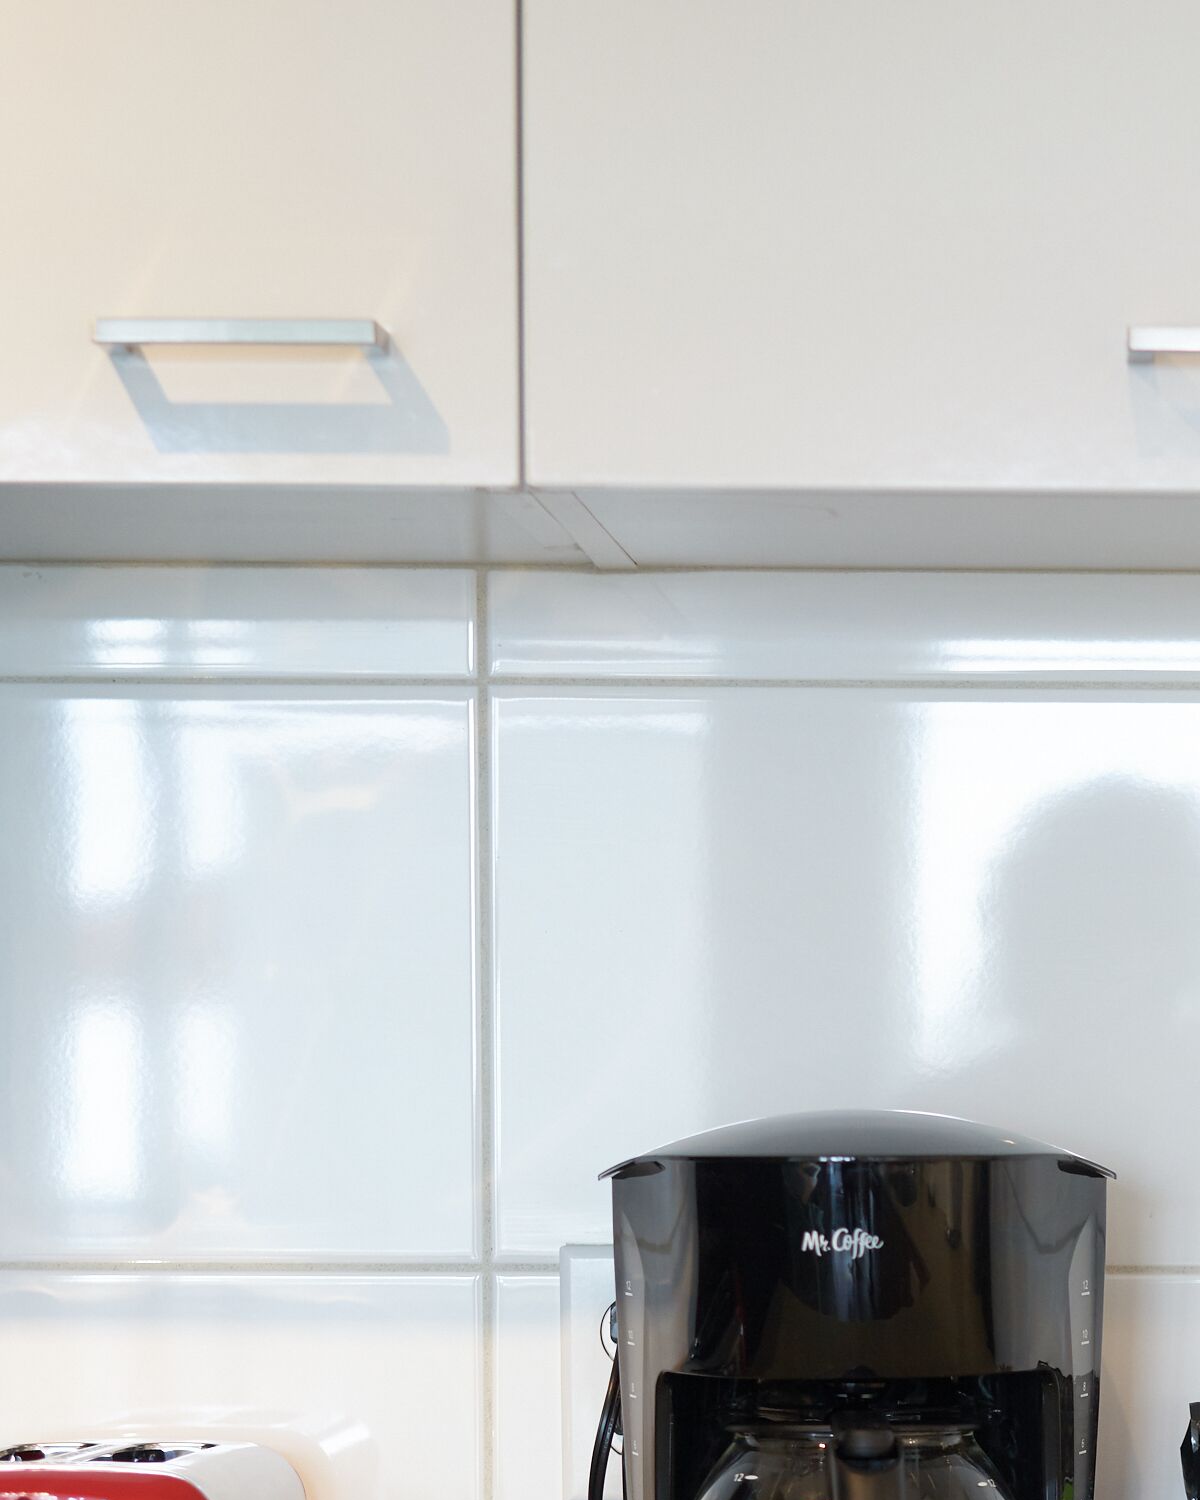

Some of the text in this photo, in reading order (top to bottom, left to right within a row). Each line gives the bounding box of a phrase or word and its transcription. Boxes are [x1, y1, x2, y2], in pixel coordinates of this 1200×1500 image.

[801, 1227, 884, 1260] Mr. Coffee
[734, 1473, 744, 1482] 12
